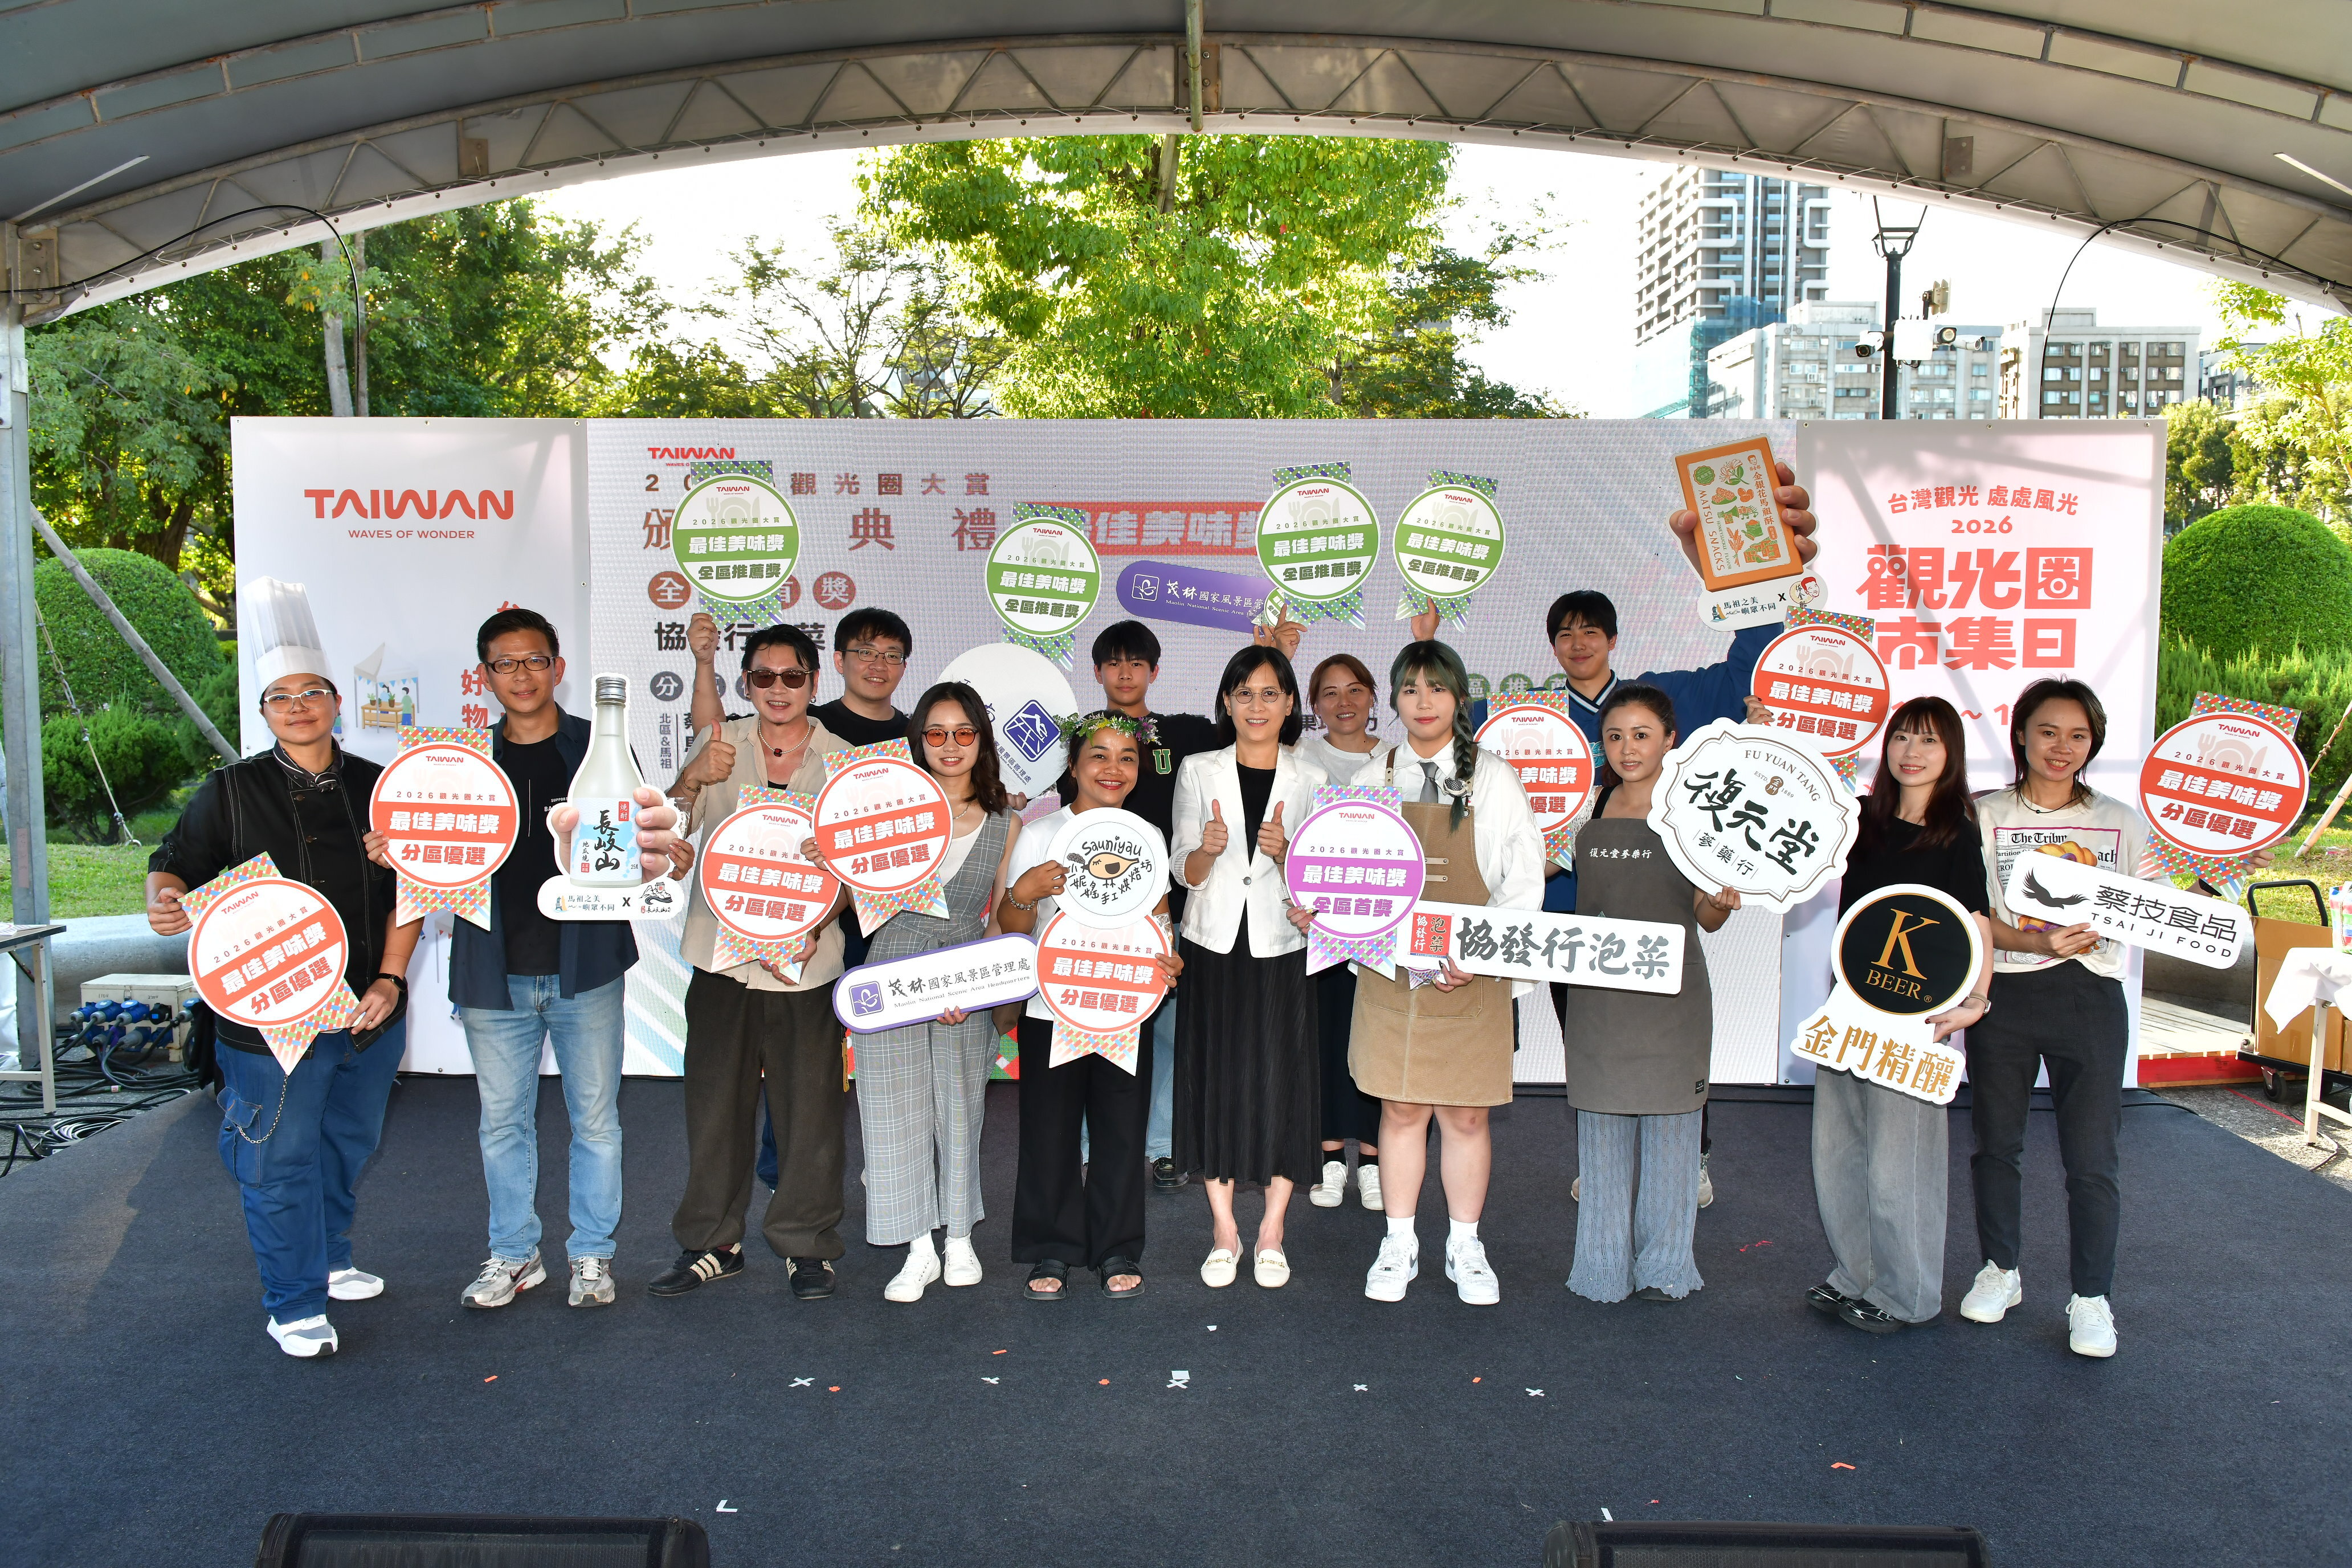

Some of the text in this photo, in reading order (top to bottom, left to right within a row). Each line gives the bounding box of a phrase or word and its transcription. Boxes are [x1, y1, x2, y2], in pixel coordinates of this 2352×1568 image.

[648, 447, 735, 459] TAIWAN
[304, 489, 514, 519] TAIWAN
[1445, 494, 1473, 503] TAIWAN
[1753, 472, 1774, 525] 金銀花馬祖酥
[1888, 485, 2079, 515] 台灣觀光 處處風光
[693, 517, 779, 525] 2026觀光圈大賞
[1276, 516, 1359, 529] 2026觀光圈大賞
[1417, 518, 1491, 536] 2026觀光圈大賞
[1698, 490, 1714, 524] MATSU
[1709, 531, 1725, 570] SNACKS
[1951, 516, 2012, 534] 2026
[348, 530, 475, 538] WAVES OF WONDER
[689, 534, 784, 554] 最佳美味獎
[1273, 533, 1364, 557] 最佳美味獎
[1406, 532, 1490, 560] 最佳美味獎
[1717, 521, 1727, 550] HONEYSUCKLE
[698, 564, 781, 580] 全區推薦獎
[1007, 555, 1084, 567] 2026觀光圈大賞
[1283, 561, 1361, 581] 全區推薦獎
[1408, 558, 1480, 582] 全區推薦獎
[1000, 571, 1087, 594] 最佳美味獎
[1856, 544, 2093, 610] 觀光圈
[1167, 579, 1264, 610] 茂林國家風景區管
[1724, 597, 1758, 609] 馬祖之美
[1005, 599, 1080, 618] 全區推薦獎
[1810, 635, 1845, 646] TAIWAN
[1876, 616, 2076, 670] 市集日
[1779, 663, 1872, 684] 2026觀光圈大賞
[1769, 680, 1873, 713] 最佳美味獎
[1777, 712, 1857, 741] 分區優選
[2218, 724, 2260, 737] TAIWAN
[854, 767, 889, 779] TAIWAN
[1517, 766, 1577, 785] 美味獎
[1745, 750, 1820, 802] FU YUAN TANG
[2175, 752, 2285, 780] 2026觀光圈大賞
[397, 791, 495, 801] 2026觀光圈大賞
[1766, 778, 1782, 794] 金門
[1781, 787, 1794, 798] 1889
[2157, 769, 2282, 812] 最佳美味獎
[834, 794, 926, 819] 2026觀光圈大賞
[1530, 796, 1565, 813] 優選
[389, 811, 500, 834] 最佳美味獎
[762, 815, 798, 824] TAIWAN
[834, 811, 935, 850] 最佳美味獎
[2161, 802, 2257, 840] 分區優選
[593, 810, 624, 871] 長岐山
[2011, 832, 2032, 843] The
[402, 844, 485, 865] 分區優選
[729, 844, 807, 860] 2026觀光圈
[851, 843, 930, 875] 分區優選
[1310, 846, 1404, 856] 2026觀光圈大賞
[717, 863, 824, 893] 最佳美味獎
[1302, 865, 1407, 887] 最佳美味獎
[221, 891, 259, 914] TAIWAN
[725, 895, 806, 922] 分區優選
[1313, 896, 1393, 917] 全區首獎
[2094, 885, 2236, 942] 蔡技食品
[214, 906, 308, 963] 2026觀光圈大賞
[1414, 914, 1428, 951] 協發行
[1429, 916, 1446, 952] 泡菜
[1871, 908, 1940, 980] K
[2092, 913, 2231, 957] TSAI JI FOOD
[220, 921, 327, 995] 最佳美味獎
[1062, 938, 1152, 954] 2026觀光圈大賞
[1456, 917, 1670, 979] 協發行泡菜
[888, 958, 1030, 997] 茂林國家風景區管理處
[987, 975, 1030, 989] Headquarters
[1052, 957, 1154, 985] 最佳美味獎
[251, 956, 333, 1015] 分區優選
[1864, 969, 1922, 1000] BEER
[1060, 989, 1138, 1013] 分區優選
[1798, 1015, 1955, 1097] 金門精釀
